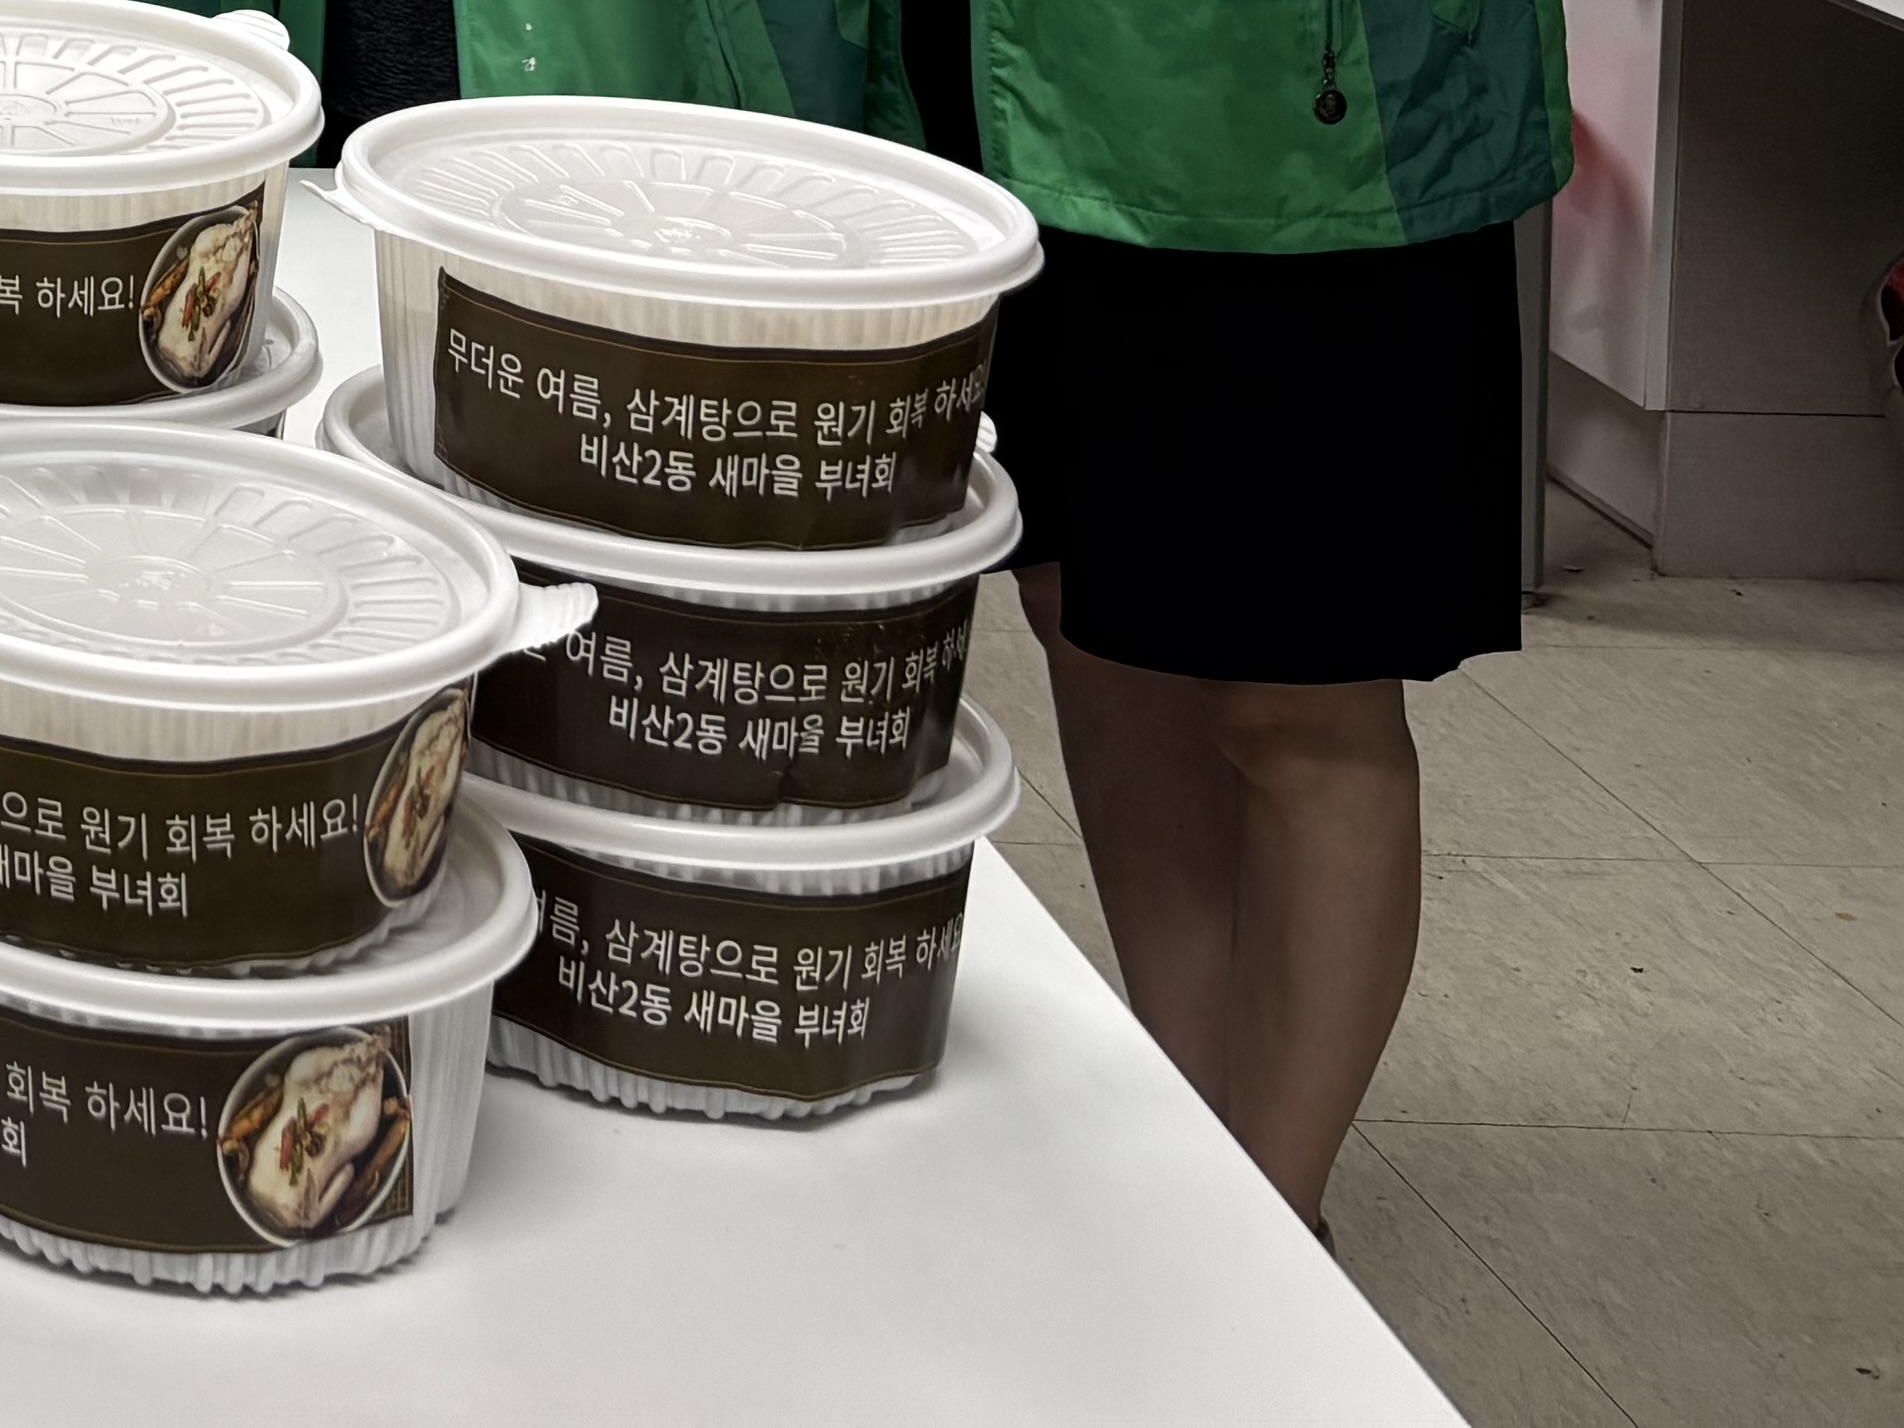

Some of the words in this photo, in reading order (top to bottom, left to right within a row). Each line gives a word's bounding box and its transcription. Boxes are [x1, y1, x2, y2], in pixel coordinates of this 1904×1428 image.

[36, 274, 135, 318] 하세요!
[447, 328, 524, 399] 무더운
[536, 366, 611, 429] 여름,
[625, 387, 798, 441] 삼계탕으로
[813, 399, 877, 446] 원기
[885, 387, 930, 439] 회복
[579, 432, 696, 492] 비산2동
[708, 454, 803, 498] 새마을
[815, 452, 898, 503] 부녀회
[565, 630, 643, 691] 여름,
[658, 650, 829, 705] 삼계탕으로
[840, 657, 896, 706] 원기
[902, 647, 937, 694] 회복
[608, 696, 727, 756] 비산2동
[739, 713, 825, 761] 새마을
[835, 706, 911, 759] 부녀회
[80, 805, 148, 861] 원기
[166, 812, 236, 863] 회복
[249, 793, 360, 851] 하세요!
[90, 865, 190, 917] 부녀회
[605, 918, 780, 985] 삼계탕으로
[793, 944, 854, 991] 원기
[861, 934, 907, 985] 회복
[557, 955, 672, 1027] 비산2동
[683, 988, 782, 1045] 새마을
[794, 996, 871, 1048] 부녀회
[6, 1061, 71, 1124] 회복
[85, 1081, 209, 1139] 하세요!
